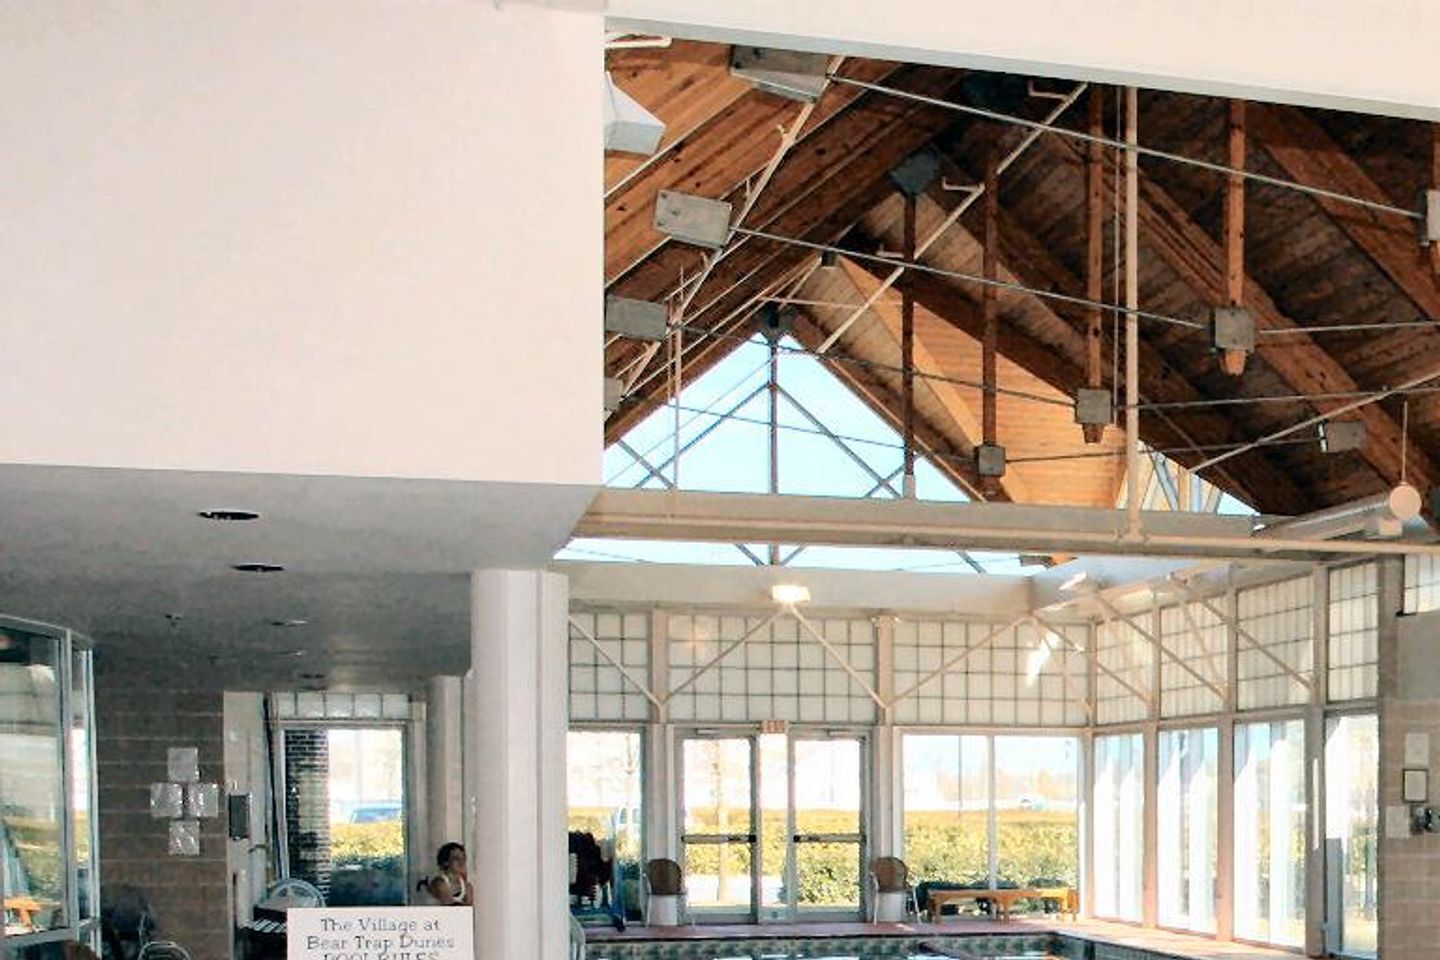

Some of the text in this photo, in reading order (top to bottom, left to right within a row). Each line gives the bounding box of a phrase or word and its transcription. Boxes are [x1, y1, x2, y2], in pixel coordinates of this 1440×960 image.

[320, 917, 441, 934] The Village at
[307, 934, 455, 953] Bear Trap Dunes
